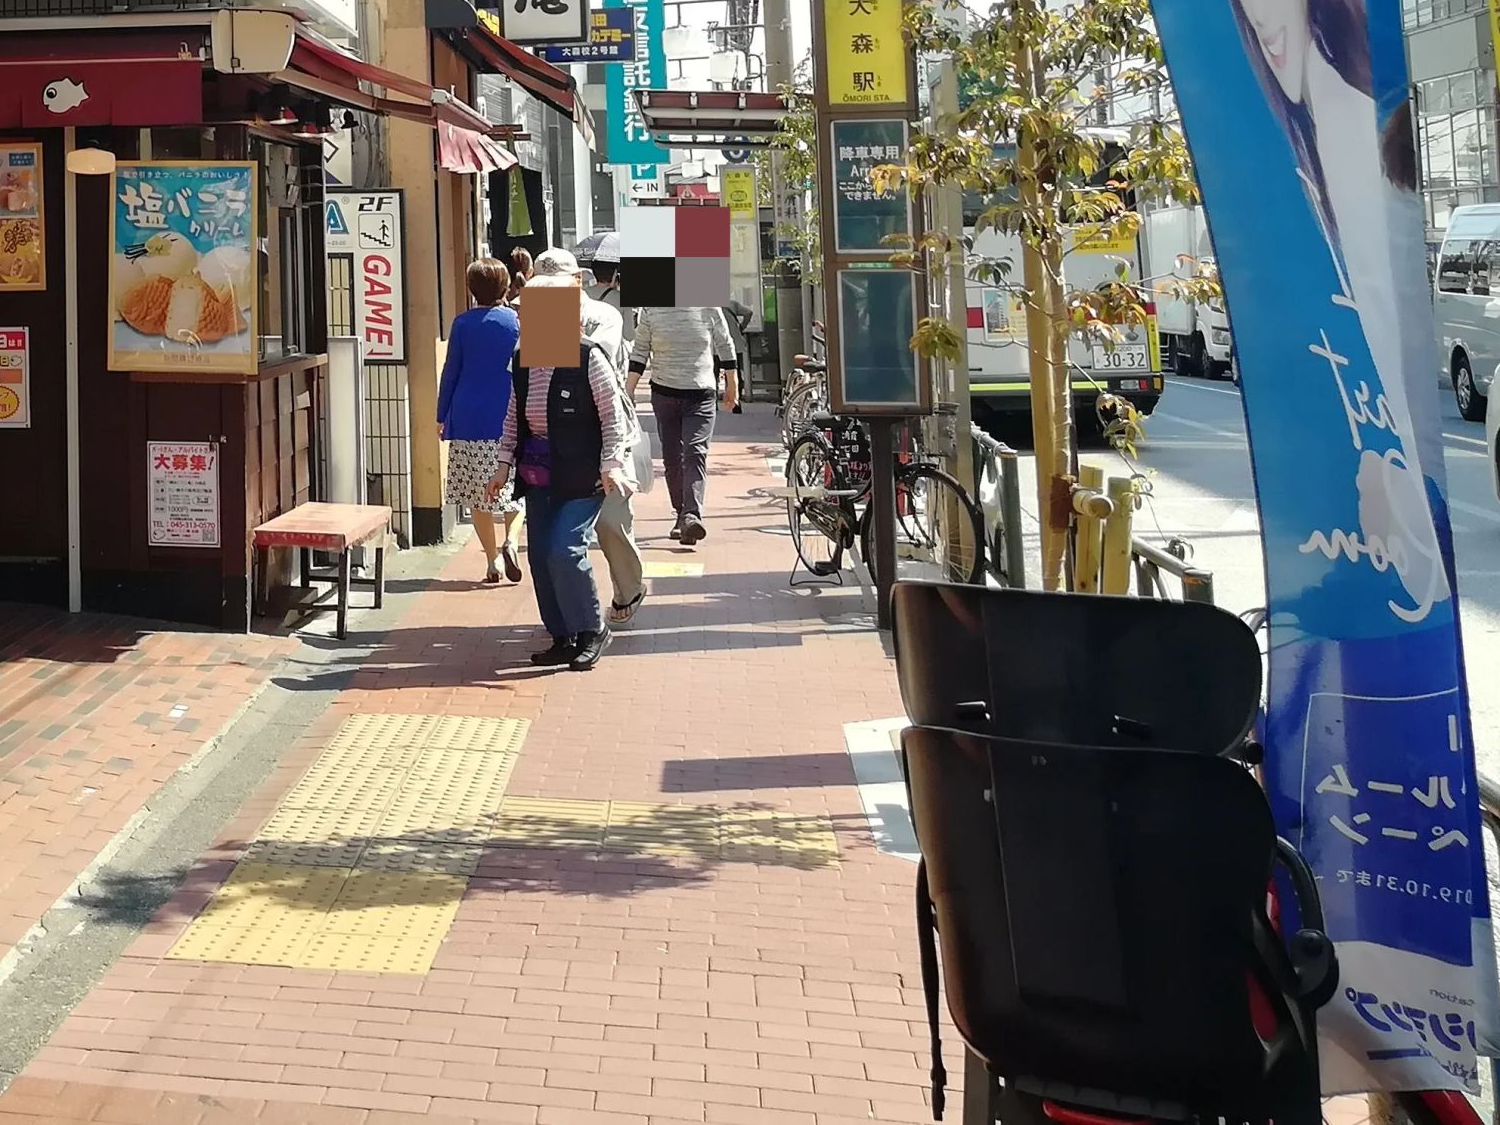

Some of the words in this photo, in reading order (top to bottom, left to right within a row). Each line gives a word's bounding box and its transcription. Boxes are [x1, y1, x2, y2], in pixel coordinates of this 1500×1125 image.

[839, 145, 900, 162] 降車専用
[647, 182, 659, 193] IN
[117, 181, 247, 229] 塩バニラ
[357, 196, 394, 212] 2F
[154, 454, 215, 472] 大募集!
